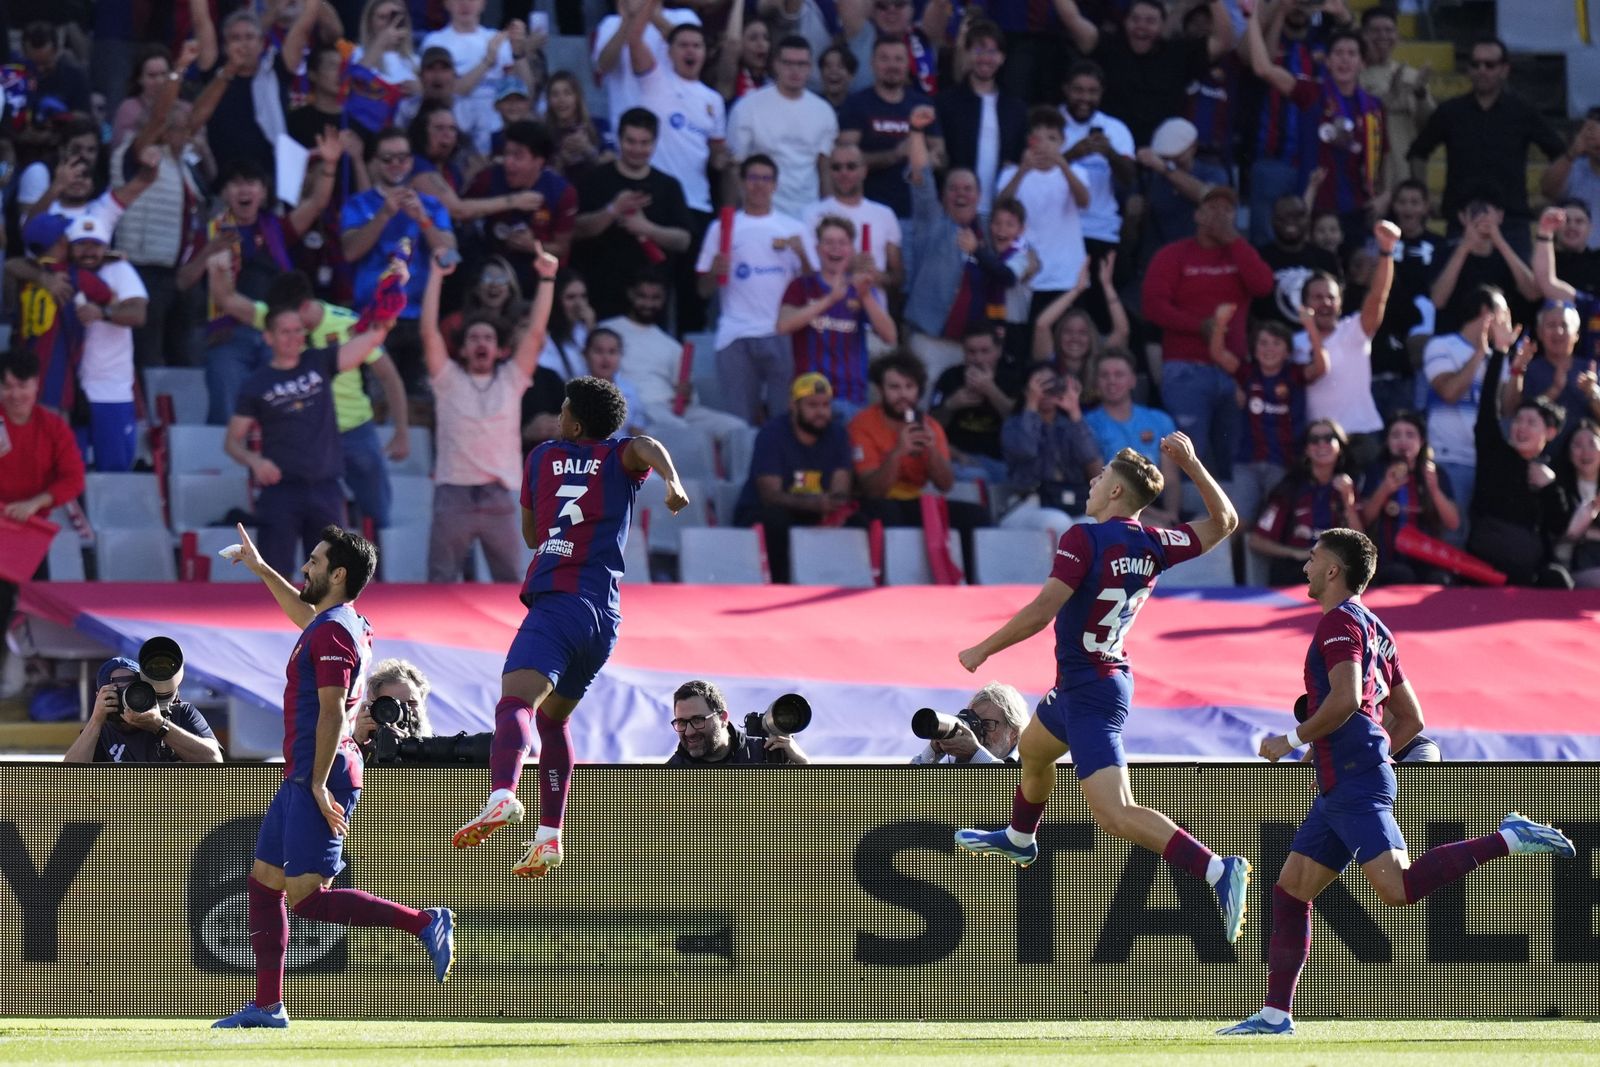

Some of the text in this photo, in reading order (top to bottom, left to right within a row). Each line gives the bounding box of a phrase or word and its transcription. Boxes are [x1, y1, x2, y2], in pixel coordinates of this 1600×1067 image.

[21, 284, 57, 338] 10
[552, 458, 601, 476] BALDE
[548, 484, 589, 538] 3
[546, 545, 573, 556] ACNUR
[548, 538, 575, 550] UNHCR
[1323, 635, 1350, 646] AMBILIGHT
